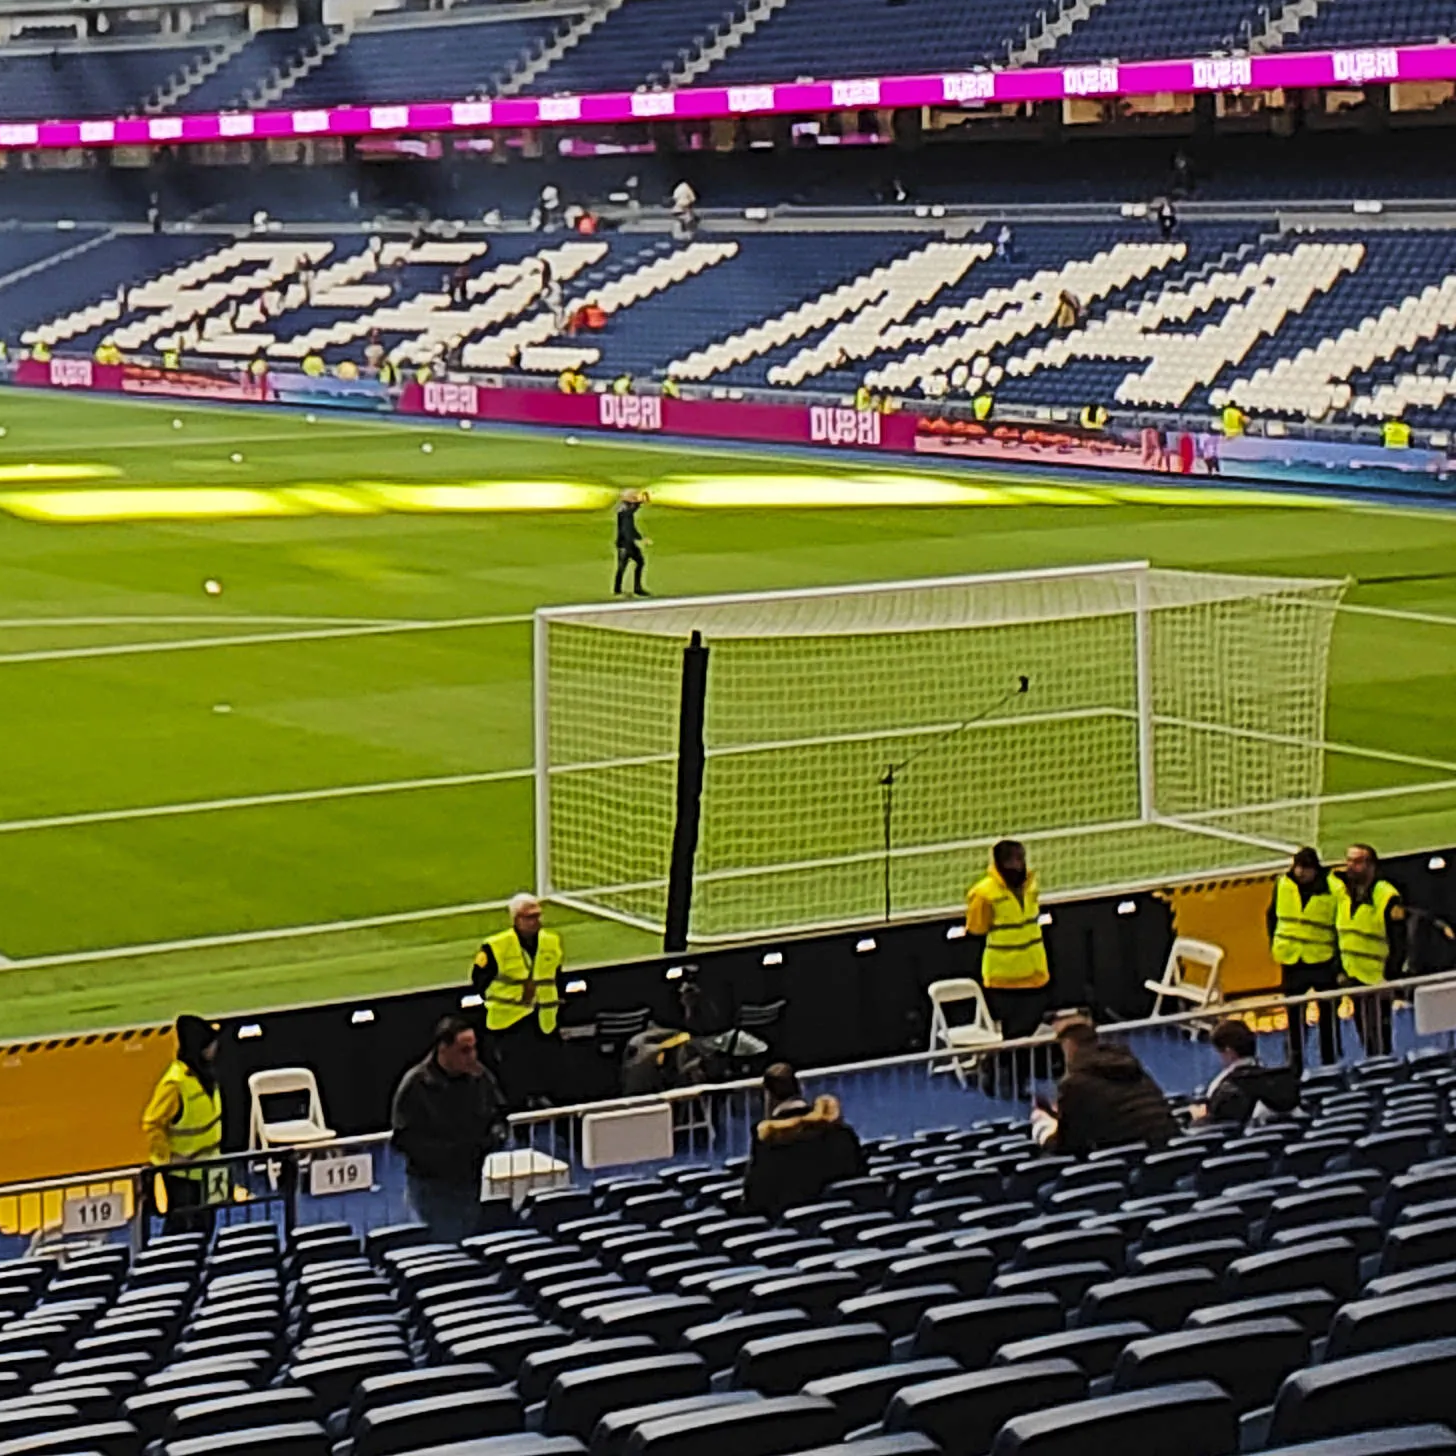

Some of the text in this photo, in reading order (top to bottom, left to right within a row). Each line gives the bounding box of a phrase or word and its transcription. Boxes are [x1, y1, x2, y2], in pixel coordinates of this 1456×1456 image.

[1063, 67, 1118, 94] DUBAI
[1192, 58, 1252, 89] DUBAI
[1333, 48, 1399, 82] DUBAI
[943, 72, 994, 101] DUBAI
[424, 380, 478, 415] DUBAI
[600, 393, 661, 429] DUBAI
[810, 406, 881, 445] DUBAI
[326, 1163, 358, 1185] 119
[77, 1202, 113, 1225] 119
